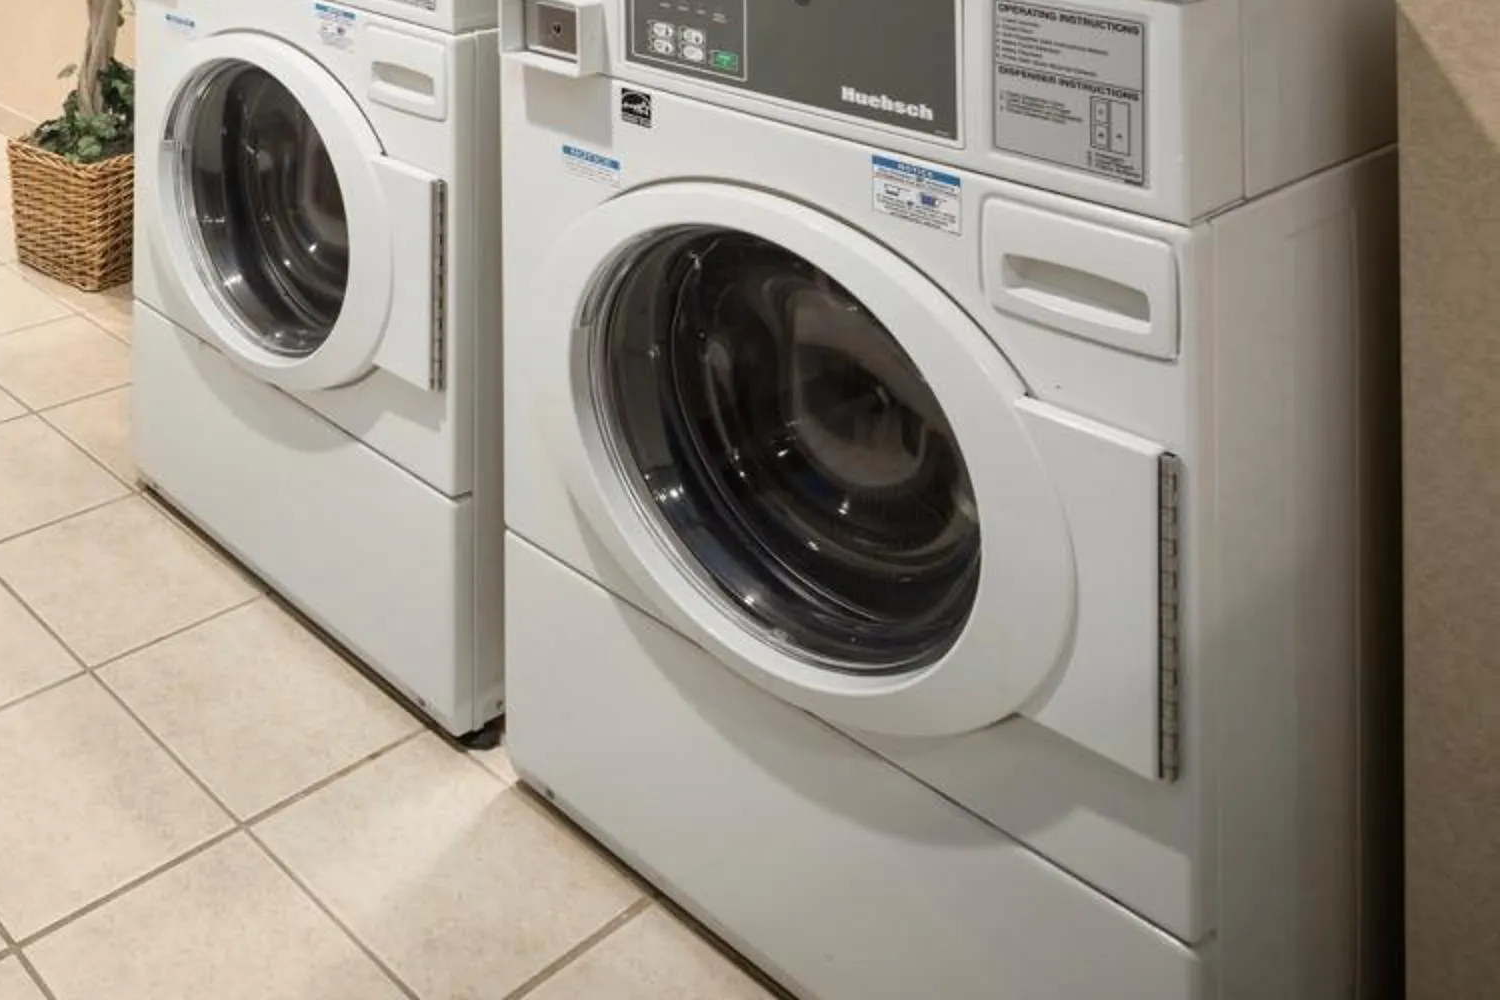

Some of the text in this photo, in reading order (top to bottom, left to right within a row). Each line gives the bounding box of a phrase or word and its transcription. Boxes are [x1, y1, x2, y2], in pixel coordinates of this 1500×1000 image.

[998, 2, 1057, 22] OPERATING
[1059, 13, 1140, 36] INSTRUCTIONS
[841, 85, 934, 121] Huebsch
